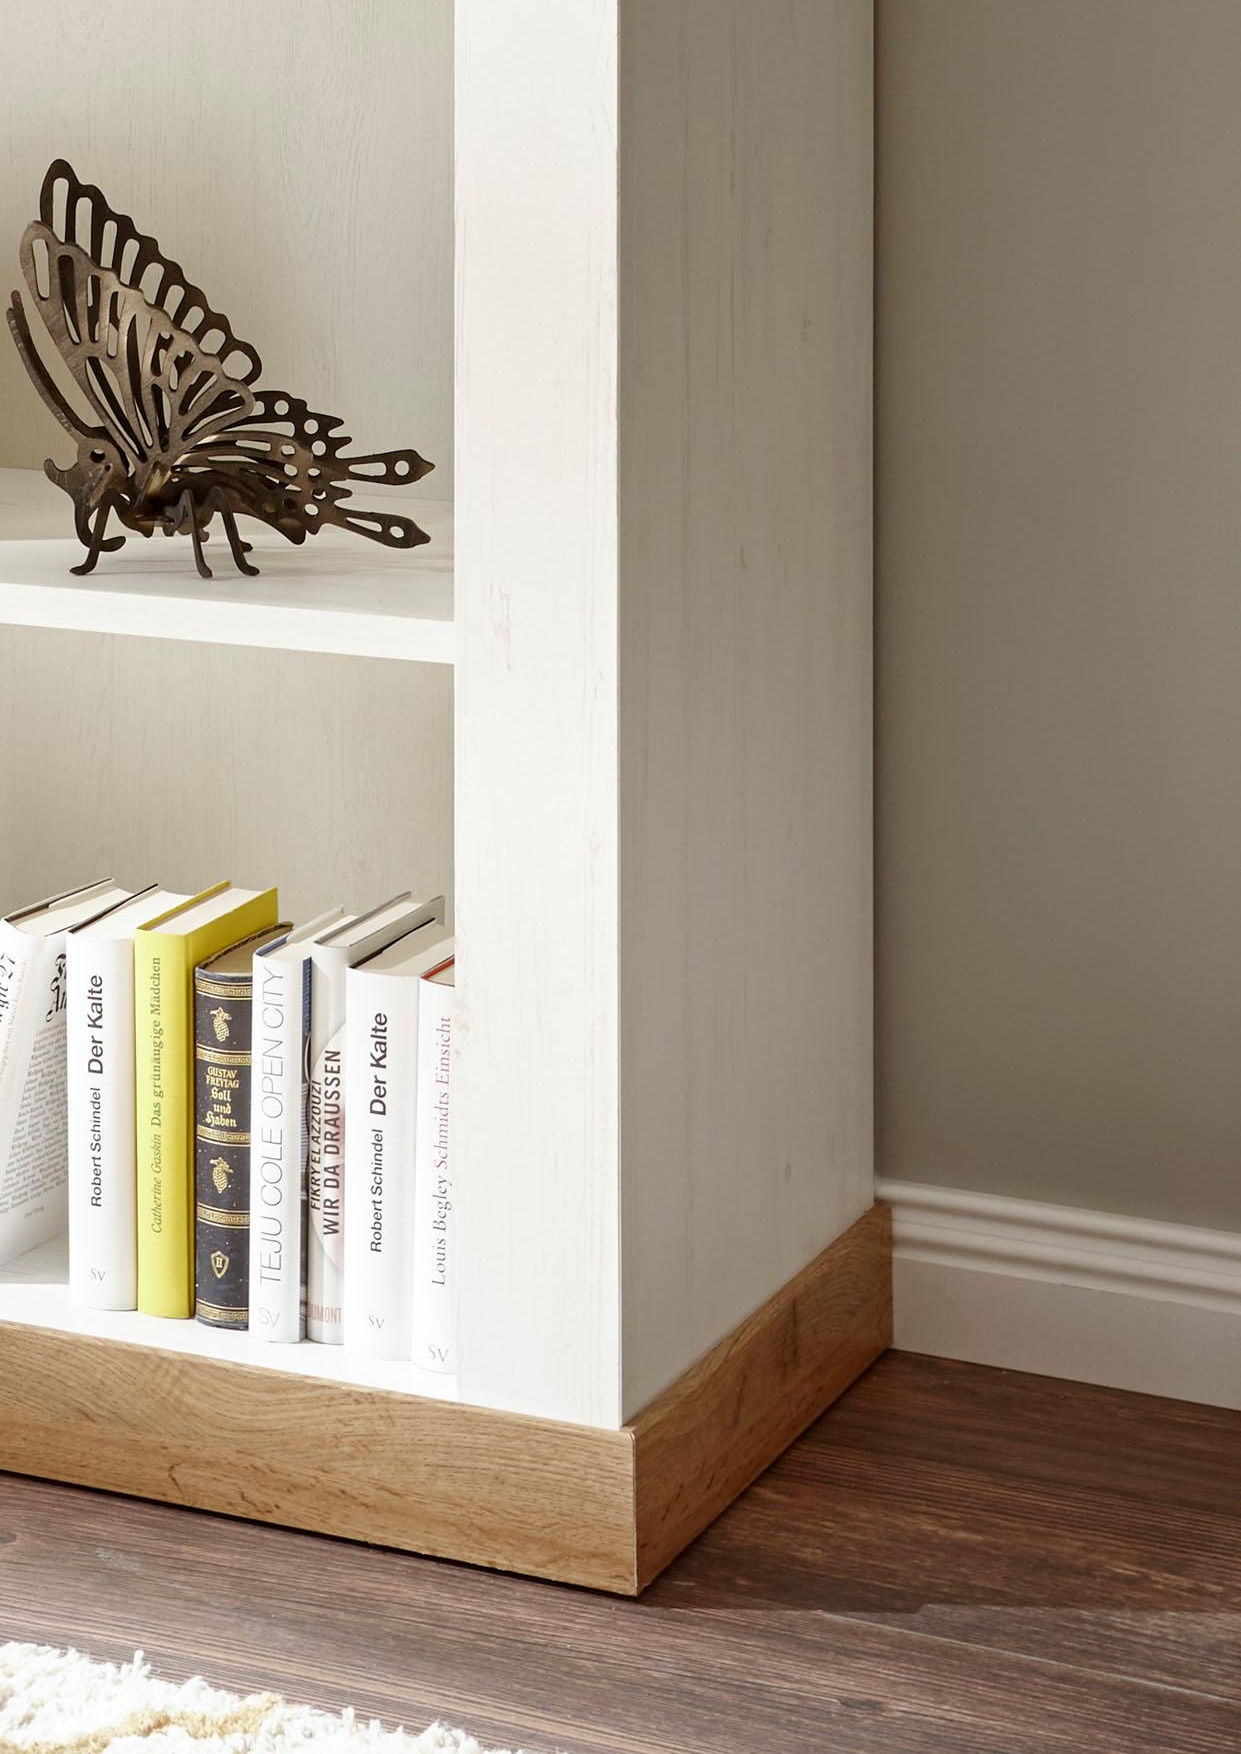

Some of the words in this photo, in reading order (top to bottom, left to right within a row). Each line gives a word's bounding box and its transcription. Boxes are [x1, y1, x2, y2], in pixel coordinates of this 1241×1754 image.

[87, 974, 103, 1028] Kalte
[150, 957, 161, 1015] Mädchen
[262, 966, 284, 1029] CITY
[88, 1035, 104, 1074] Der
[150, 1020, 164, 1098] grünäugige
[370, 1013, 388, 1069] Kalte
[435, 1016, 451, 1085] Einsicht
[206, 1075, 240, 1089] FREYTAG
[207, 1066, 238, 1079] GUSTAV
[211, 1086, 232, 1102] Soll
[262, 1038, 284, 1118] OPEN
[370, 1075, 387, 1116] Der
[90, 1087, 102, 1152] Schindel
[151, 1102, 161, 1127] Das
[205, 1110, 237, 1128] Haben
[213, 1103, 232, 1115] und
[311, 1080, 322, 1145] AZZOUZI
[324, 1050, 341, 1155] DRAUSSEN
[151, 1134, 162, 1174] Gaskin
[311, 1148, 321, 1164] EL
[433, 1092, 450, 1169] Schmidts
[90, 1156, 102, 1207] Robert
[261, 1126, 283, 1206] COLE
[310, 1167, 321, 1210] FIKRY
[323, 1165, 340, 1189] DA
[371, 1129, 383, 1196] Schindel
[151, 1177, 163, 1234] Catherine
[323, 1198, 340, 1235] WIR
[370, 1199, 383, 1252] Robert
[432, 1176, 453, 1231] Begley
[260, 1215, 282, 1286] TEJU
[432, 1238, 446, 1286] Louis
